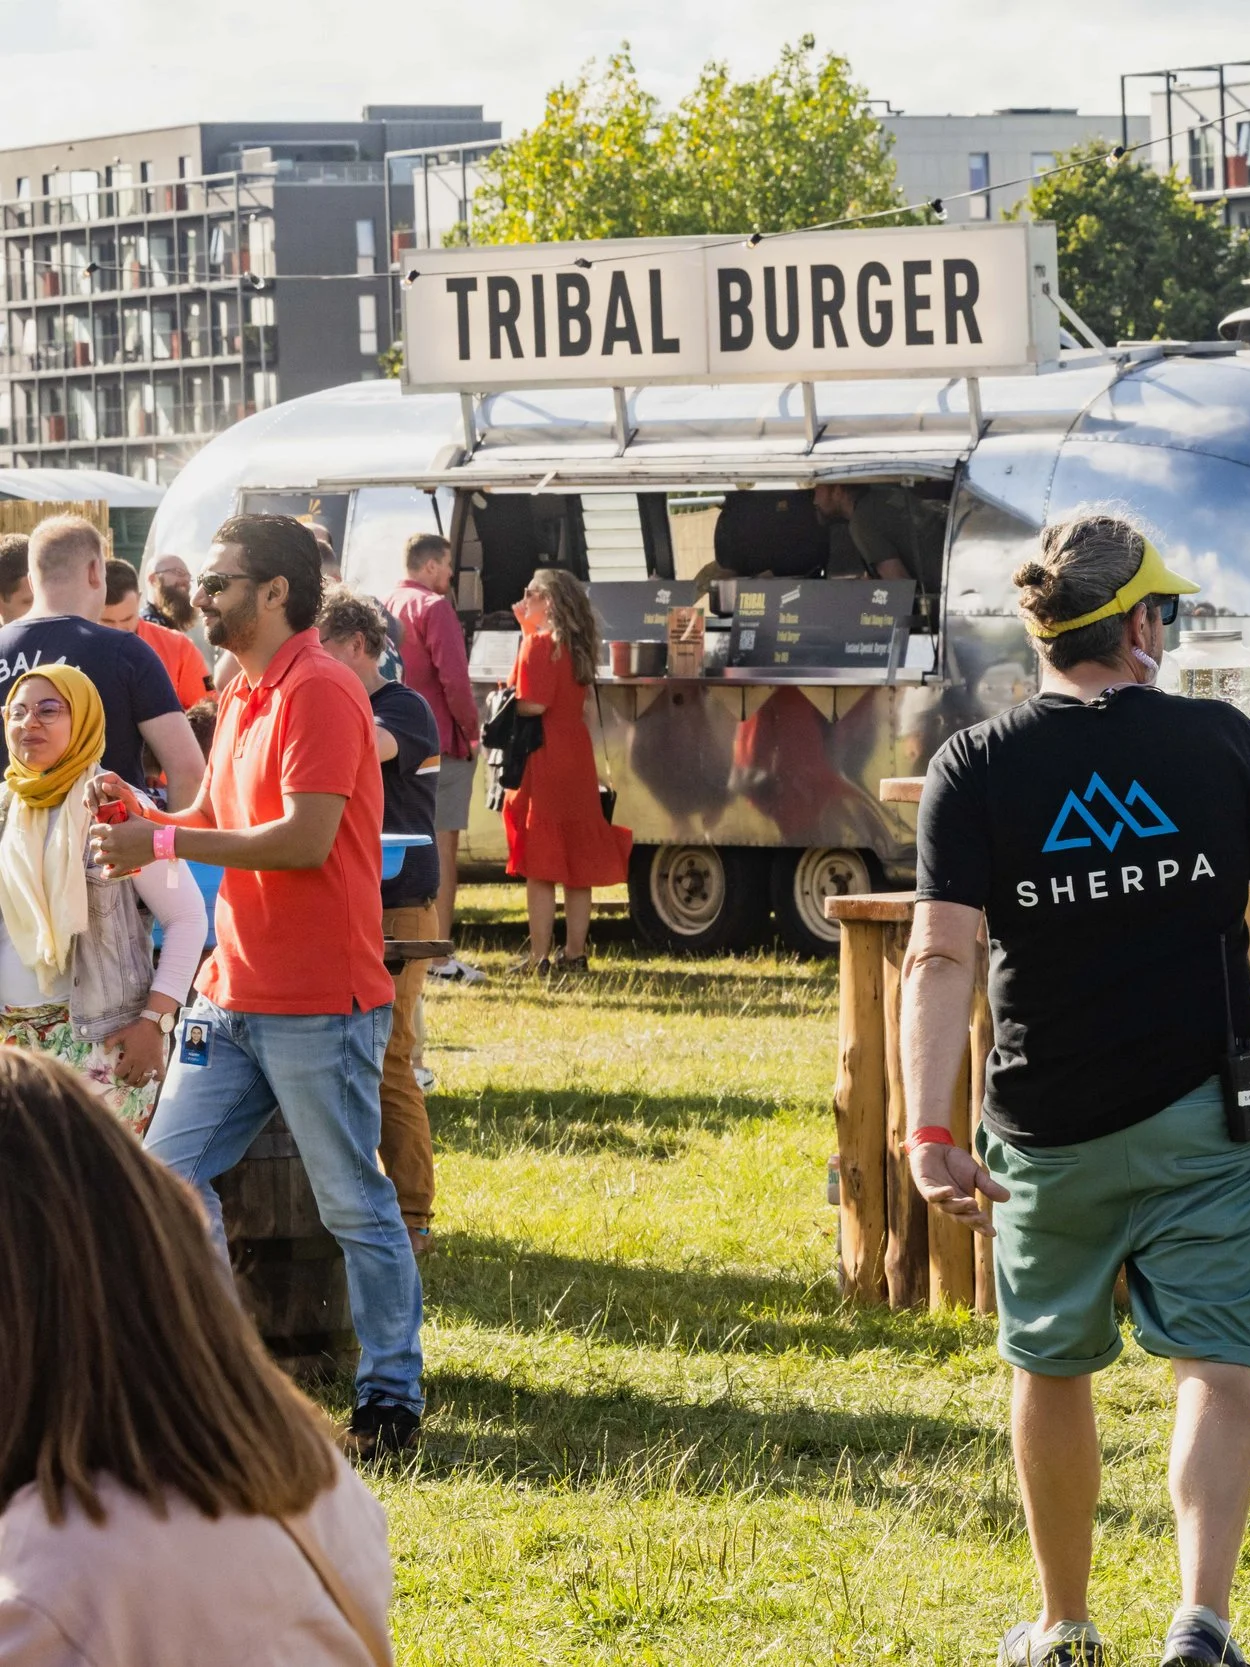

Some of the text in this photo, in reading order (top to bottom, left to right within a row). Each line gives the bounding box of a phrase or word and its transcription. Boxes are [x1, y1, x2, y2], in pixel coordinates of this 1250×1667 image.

[446, 258, 983, 361] TRIBAL BURGER
[1016, 852, 1216, 907] SHERPA
